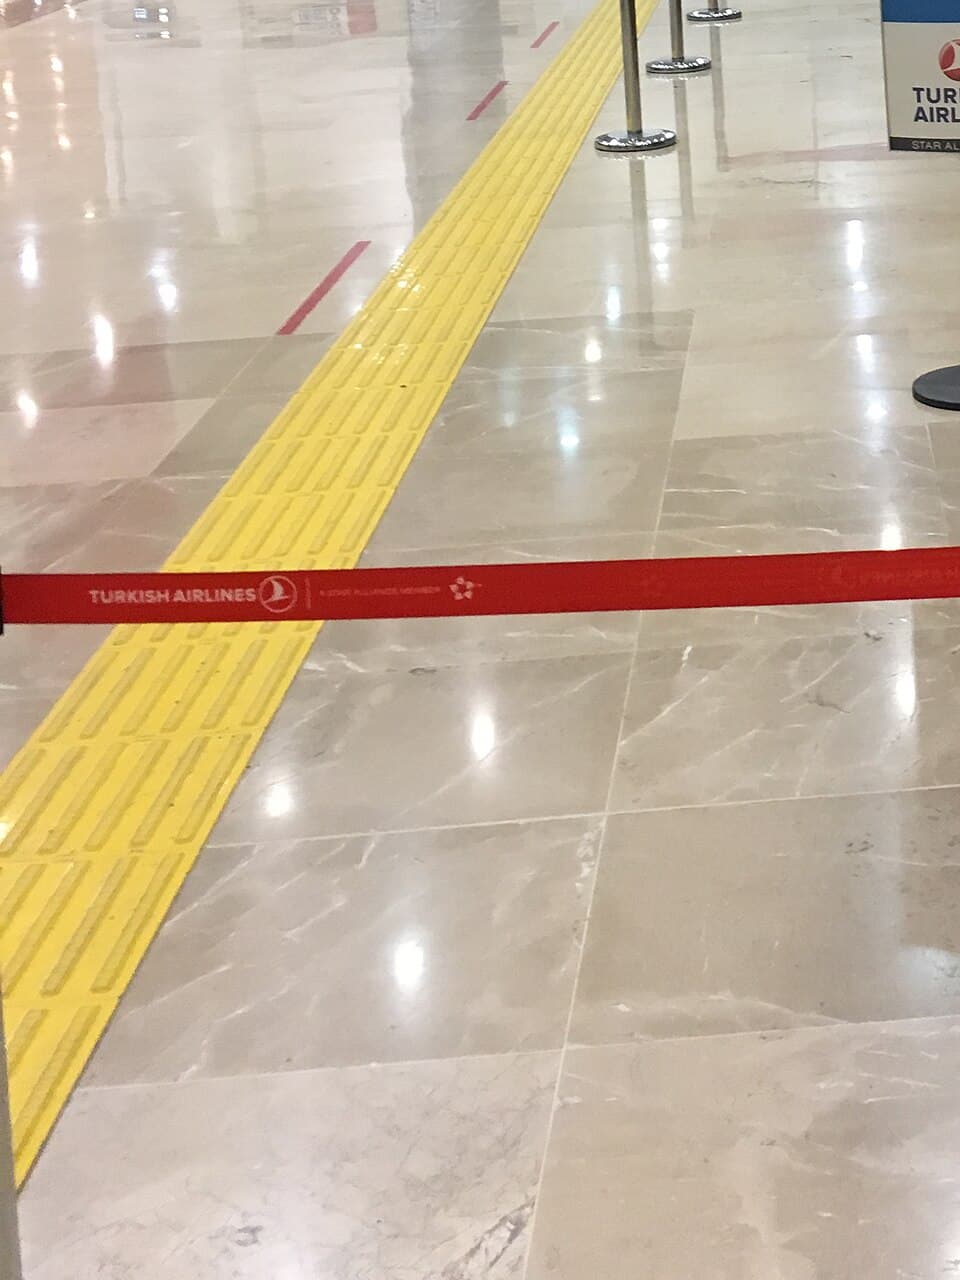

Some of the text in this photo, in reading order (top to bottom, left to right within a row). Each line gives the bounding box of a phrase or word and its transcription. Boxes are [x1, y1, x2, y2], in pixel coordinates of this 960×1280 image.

[912, 140, 942, 150] STAR
[89, 588, 170, 604] TURKISH
[173, 588, 257, 602] AIRLINES
